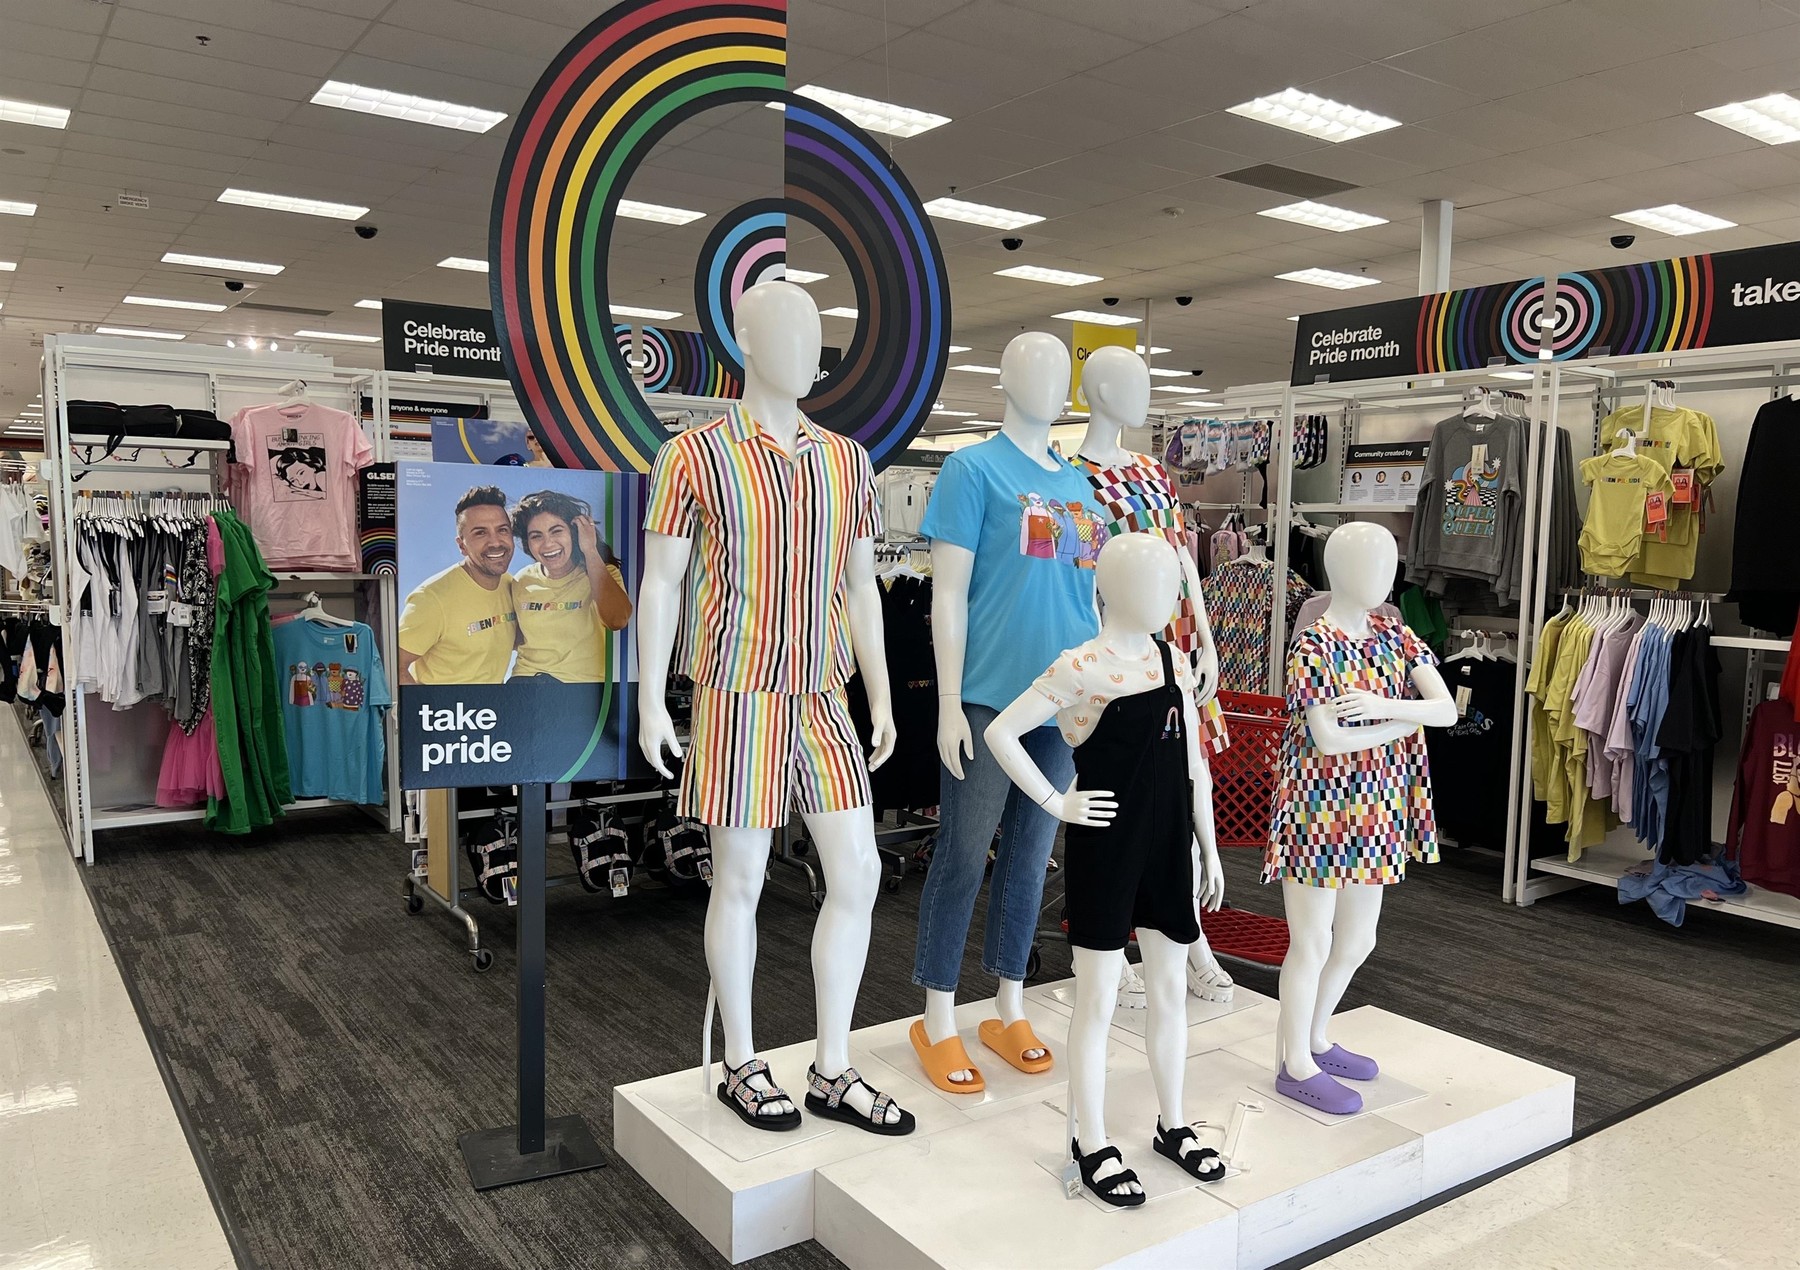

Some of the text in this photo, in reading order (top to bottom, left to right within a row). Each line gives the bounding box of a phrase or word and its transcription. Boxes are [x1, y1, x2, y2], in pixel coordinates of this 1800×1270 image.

[1731, 277, 1800, 307] take
[403, 320, 486, 344] Celebrate
[1311, 325, 1383, 348] Celebrate
[404, 338, 450, 357] Pride
[1309, 340, 1400, 366] Pride month
[390, 404, 414, 412] anyone
[420, 406, 449, 414] everyone
[1443, 504, 1495, 520] SUPER
[1442, 520, 1494, 539] QUEER
[543, 600, 583, 611] PROUD!
[418, 702, 497, 732] take
[422, 734, 513, 772] pride
[1773, 733, 1800, 758] BL
[1772, 760, 1792, 785] 1977
